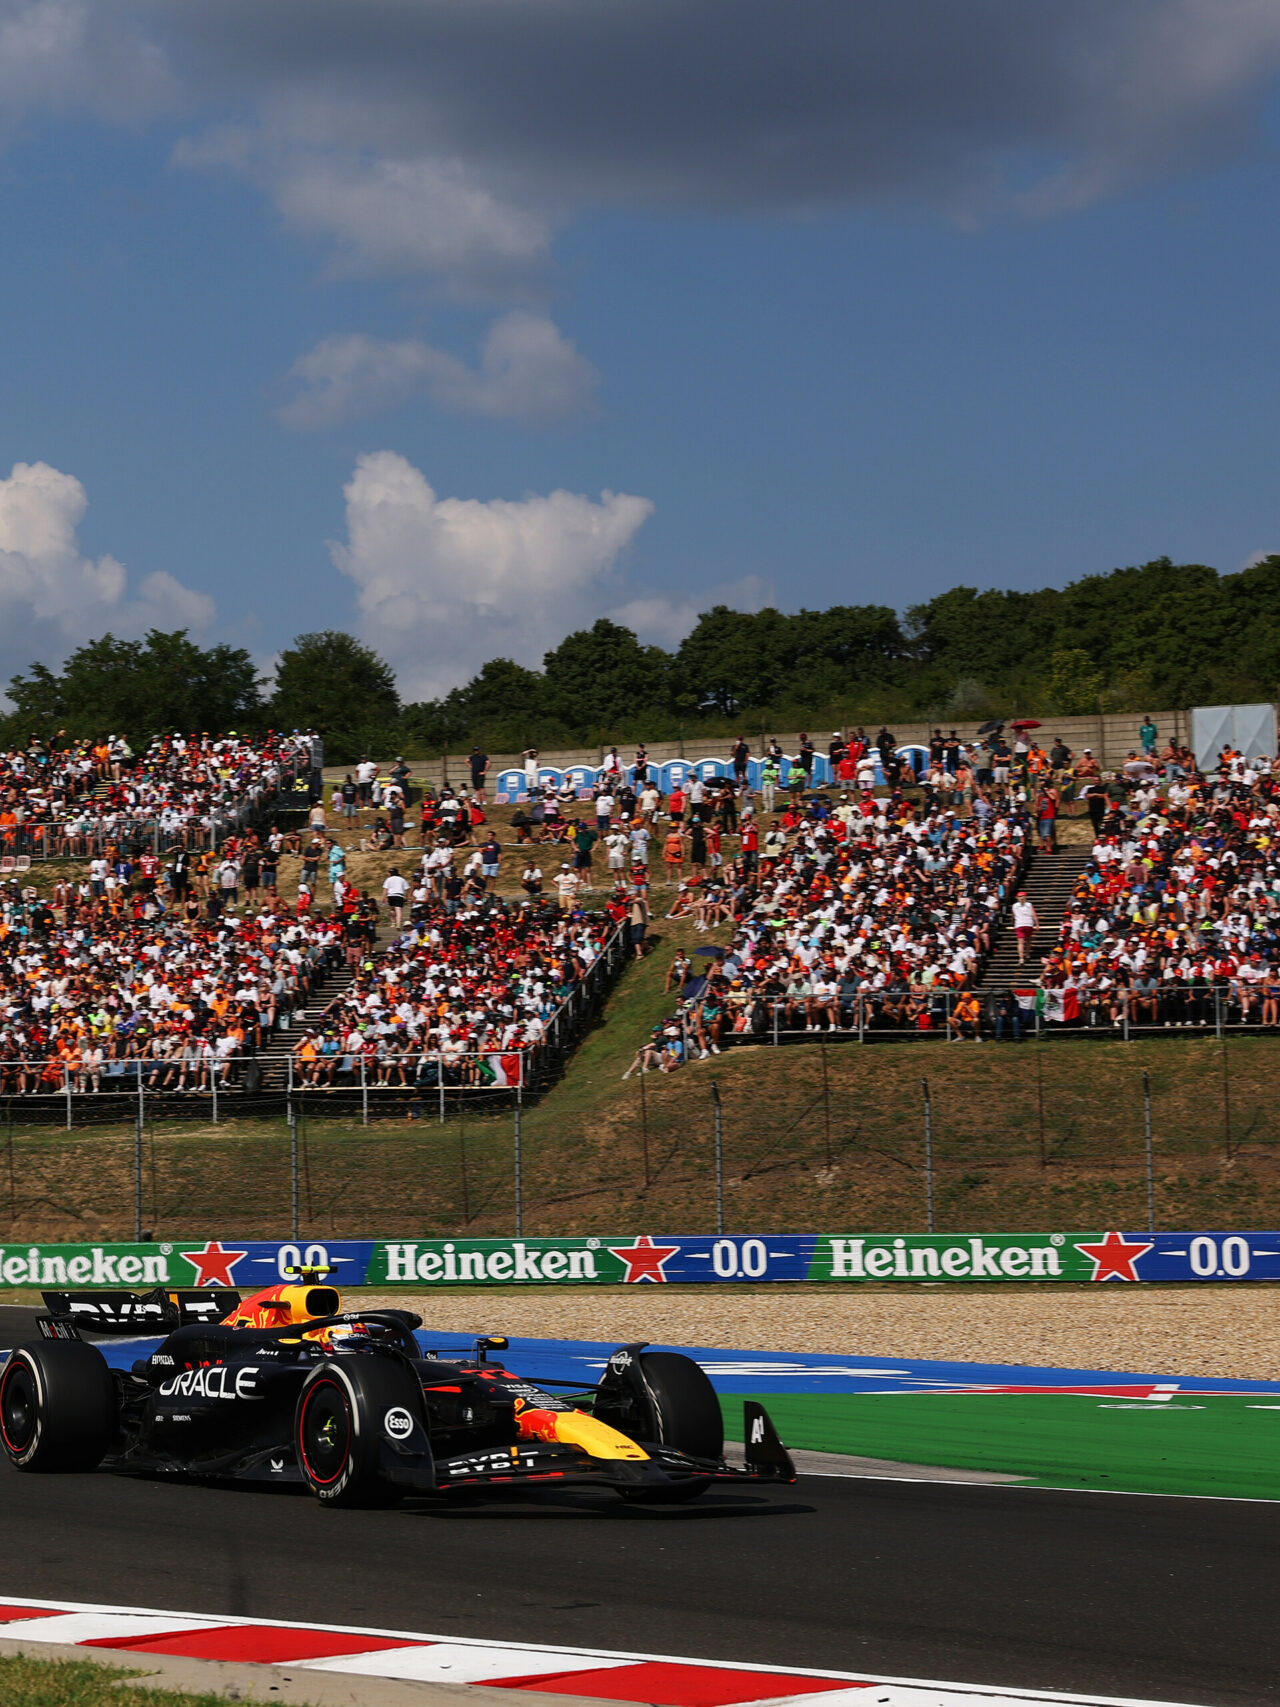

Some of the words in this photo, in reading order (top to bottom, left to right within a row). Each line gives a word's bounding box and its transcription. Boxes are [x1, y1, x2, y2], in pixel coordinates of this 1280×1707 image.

[385, 1243, 598, 1281] Heineken
[713, 1239, 767, 1278] 0.0
[829, 1239, 1063, 1277] Heineken
[1190, 1236, 1250, 1276] 0.0
[151, 1354, 175, 1365] HONDA
[160, 1366, 265, 1400] ORACLE
